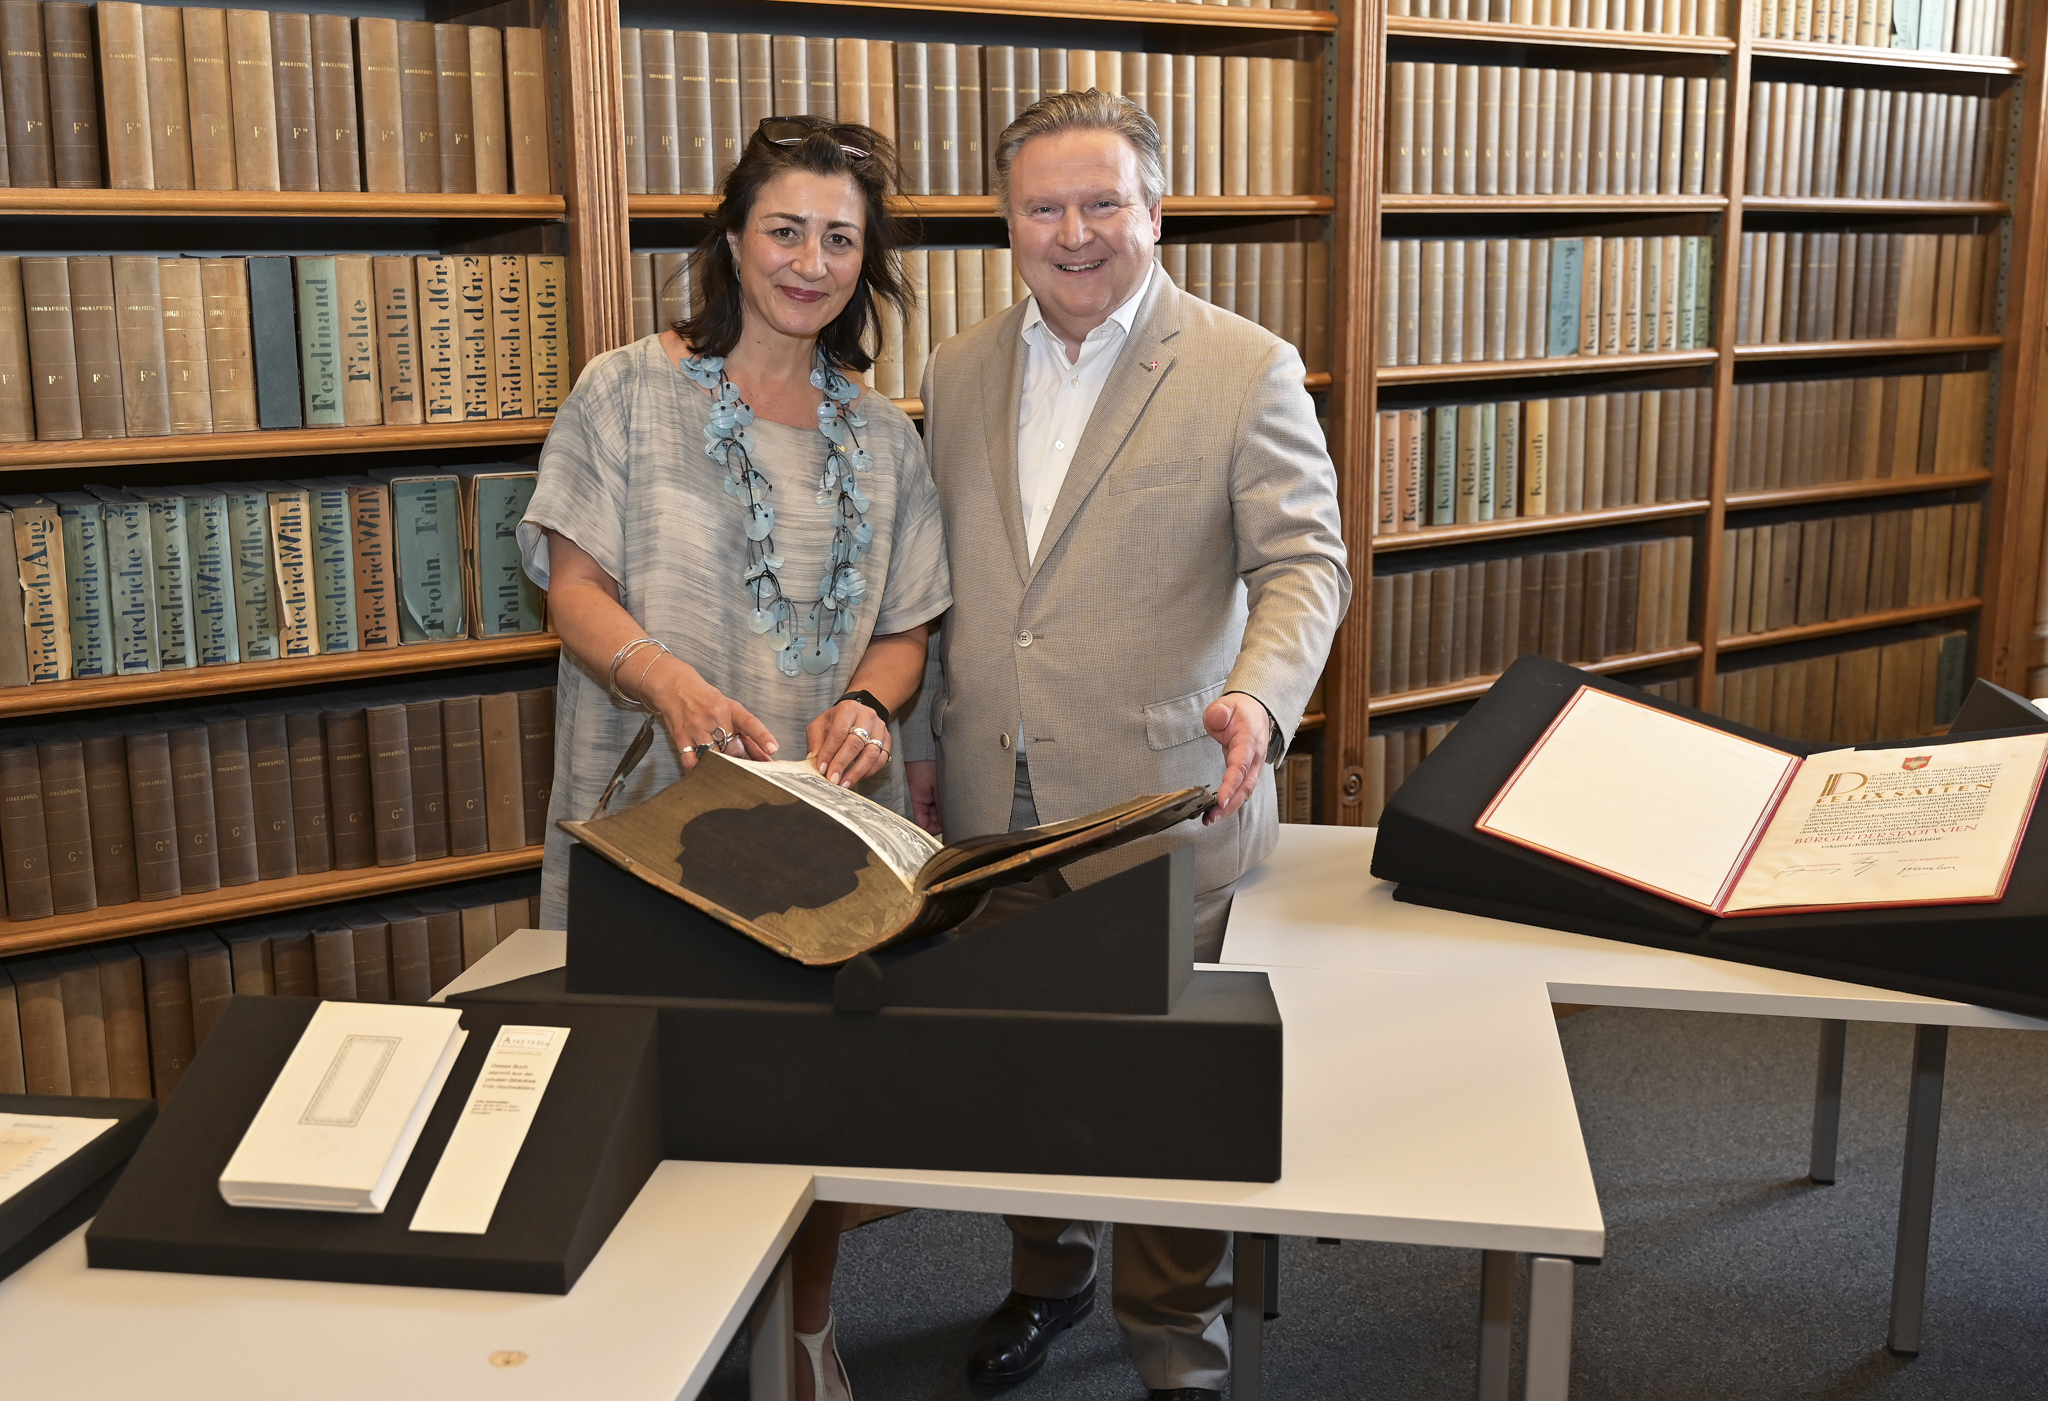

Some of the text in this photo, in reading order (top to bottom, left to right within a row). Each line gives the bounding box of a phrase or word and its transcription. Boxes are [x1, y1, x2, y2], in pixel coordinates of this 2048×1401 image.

[306, 279, 335, 413] Ferdinand
[348, 300, 371, 383] Fichte
[386, 288, 413, 404] Franklin
[1644, 313, 1656, 349] Karl
[1661, 311, 1673, 348] Karl
[1681, 309, 1691, 343] Karl
[1381, 438, 1394, 524] Katharina
[1403, 436, 1418, 522] Katharina
[1462, 448, 1475, 496] Kleist
[1530, 434, 1544, 496] Kossuth
[414, 482, 445, 632] Frohn. Füh.
[495, 488, 523, 632] Füllst. Fys.
[23, 515, 59, 683] Friedrich Aug.
[1793, 834, 1853, 844] BÜRGER
[1888, 828, 1932, 837] STADT
[1932, 824, 1978, 833] WIEN
[1816, 791, 1884, 803] FELIX
[1893, 782, 1993, 797] SALTEN
